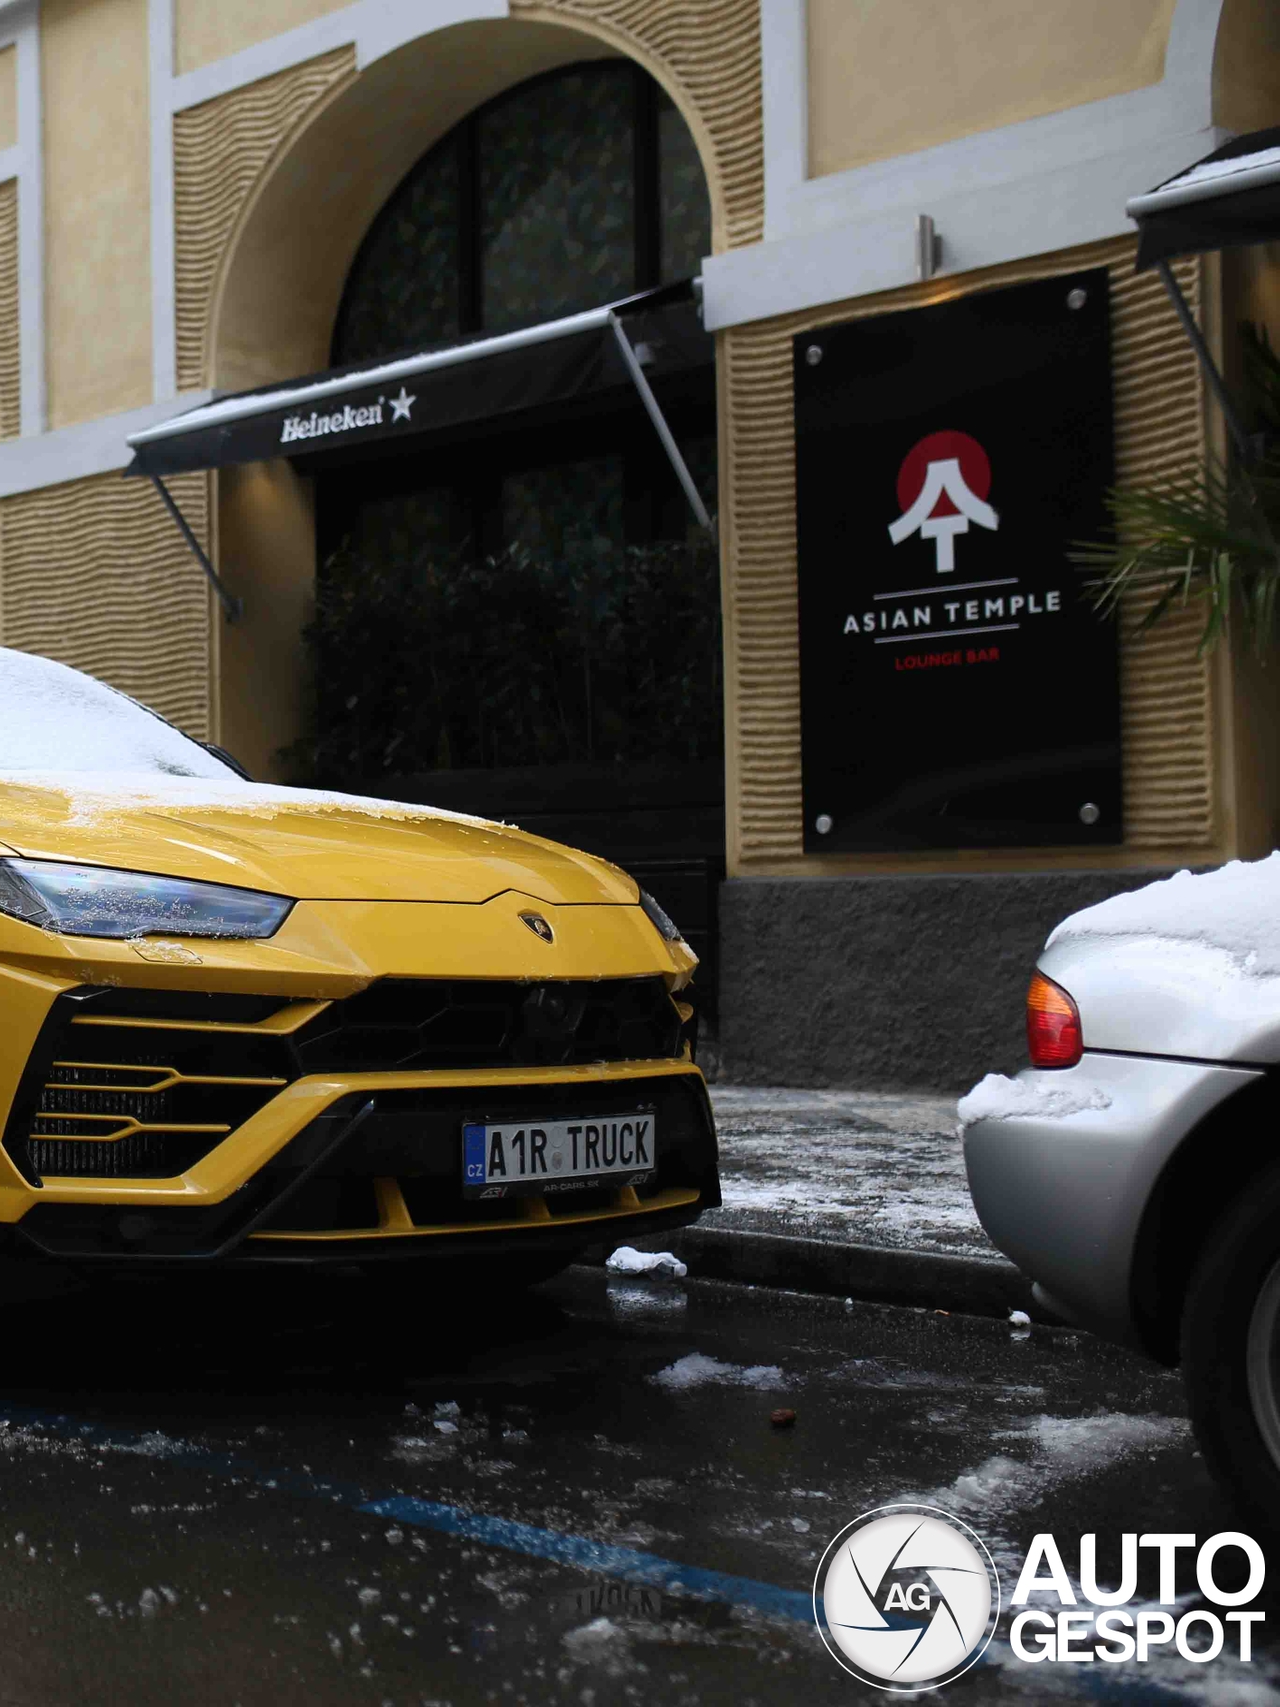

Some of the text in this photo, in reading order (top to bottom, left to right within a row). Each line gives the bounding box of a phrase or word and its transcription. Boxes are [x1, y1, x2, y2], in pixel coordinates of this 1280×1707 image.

[279, 404, 384, 443] Heineken
[843, 590, 1062, 634] ASIAN TEMPLE
[894, 646, 1000, 671] LOUNGE BAR
[488, 1121, 649, 1177] A1R TRUCK
[467, 1164, 483, 1177] CZ
